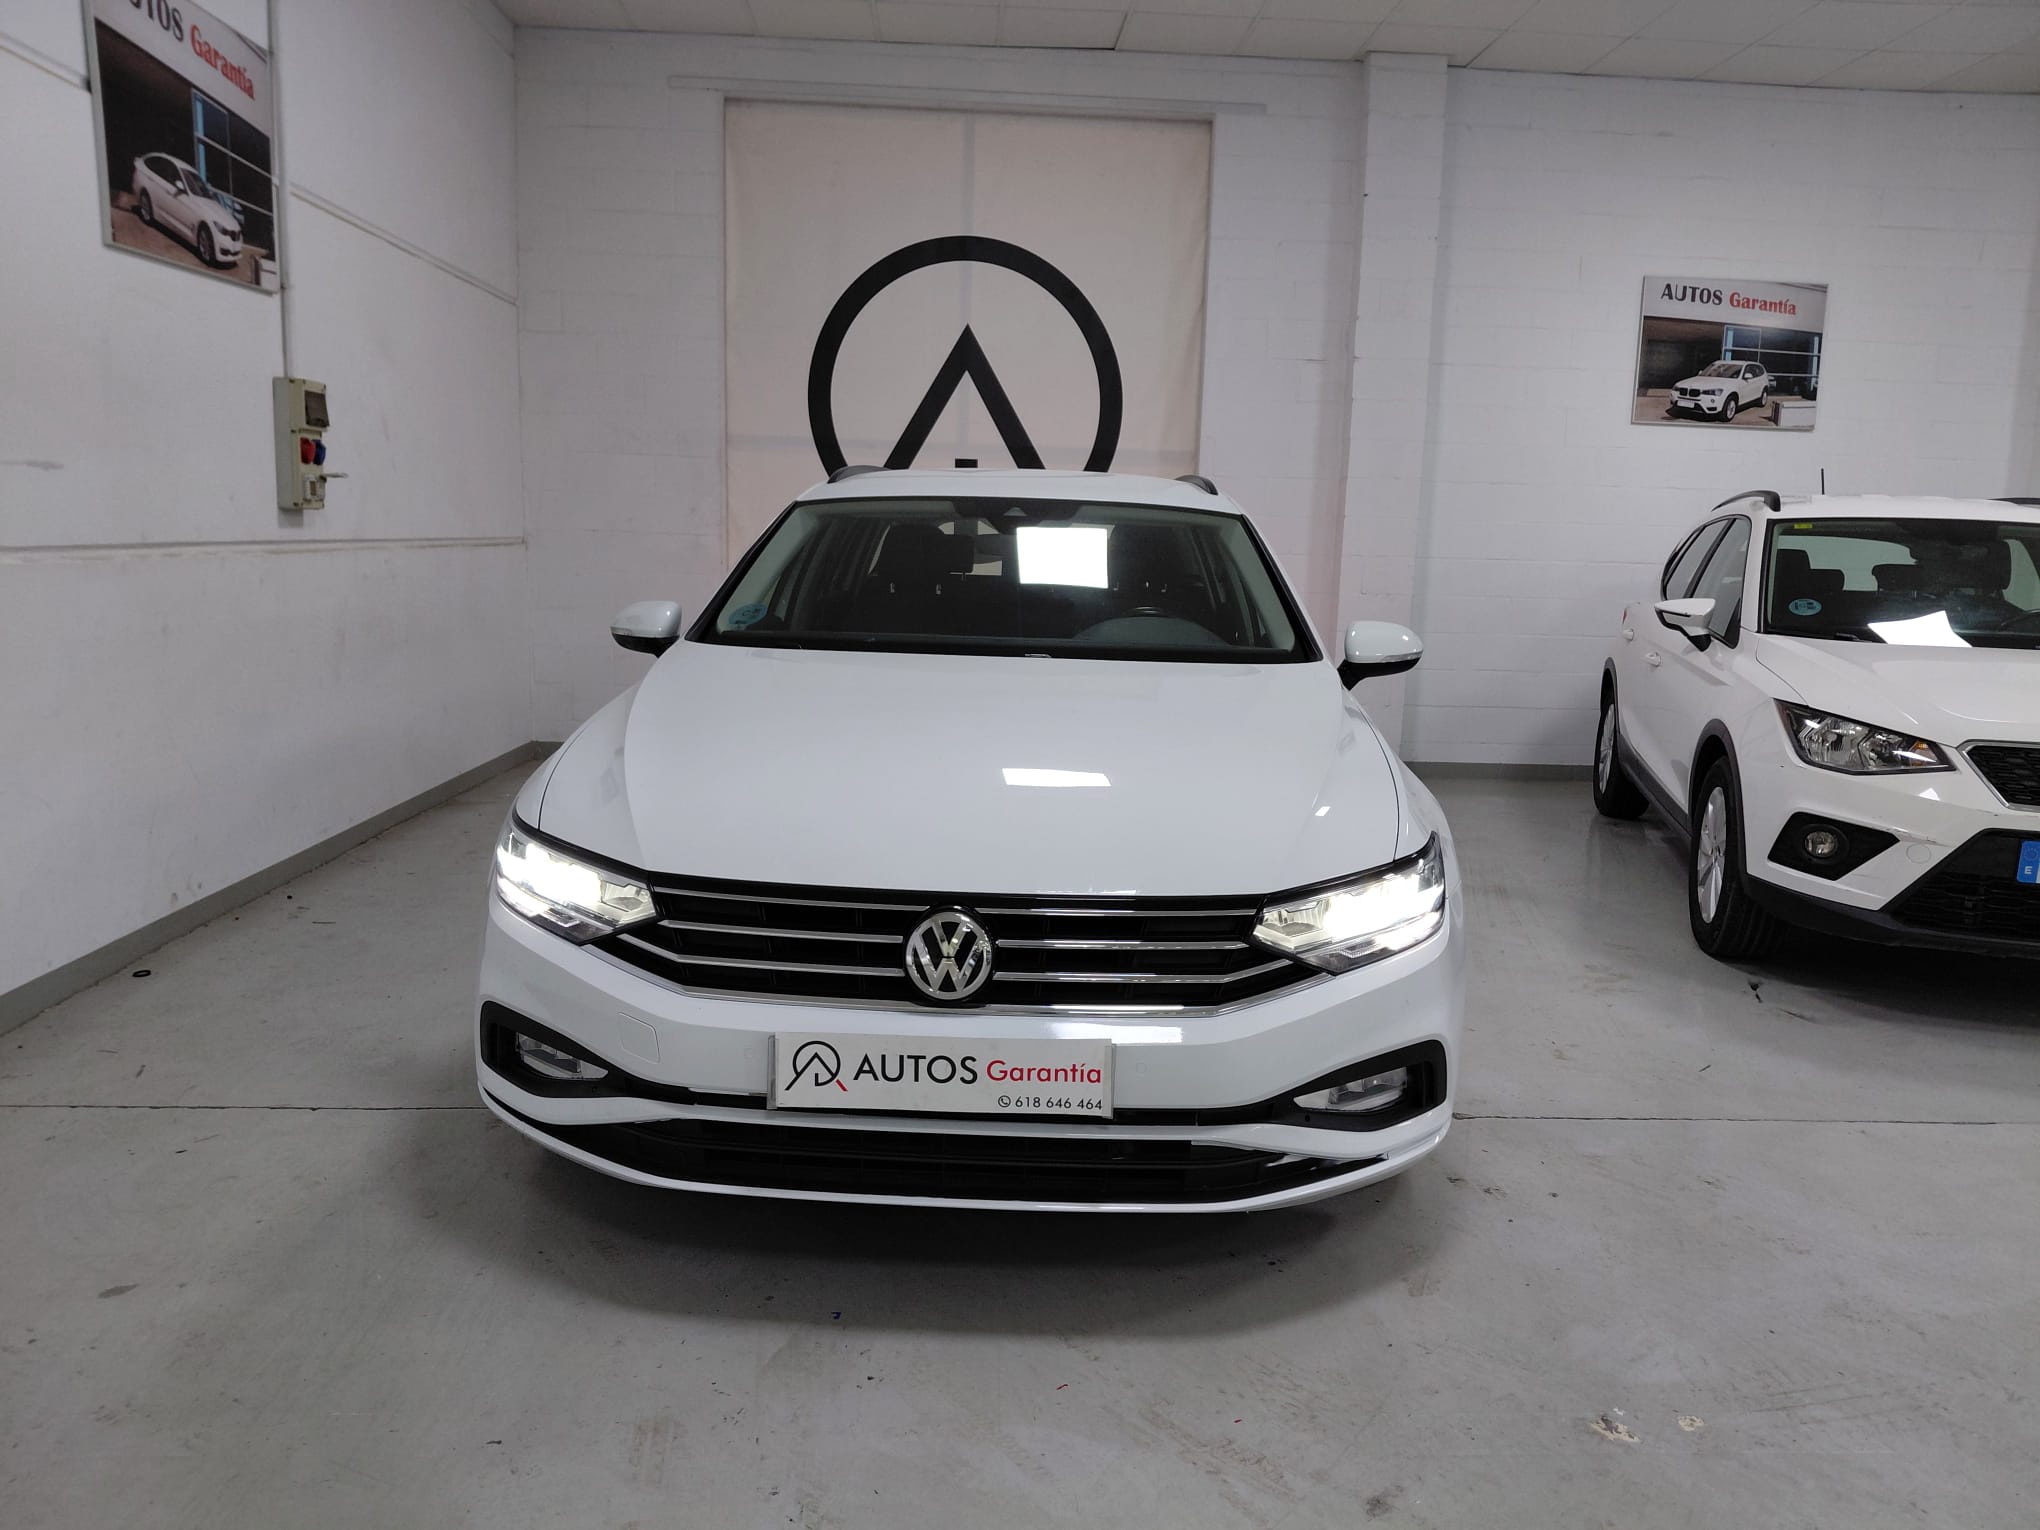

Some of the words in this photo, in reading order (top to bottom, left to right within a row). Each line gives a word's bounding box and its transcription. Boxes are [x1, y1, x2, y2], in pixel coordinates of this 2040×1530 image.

[129, 0, 184, 42] TOS
[1661, 283, 1723, 306] AUTOS
[1729, 291, 1797, 315] Garantía
[2024, 865, 2033, 875] E
[853, 1053, 978, 1085] AUTOS
[986, 1059, 1101, 1084] Garantía
[1015, 1096, 1041, 1109] 618
[1046, 1097, 1072, 1109] 646
[1077, 1098, 1103, 1110] 464
